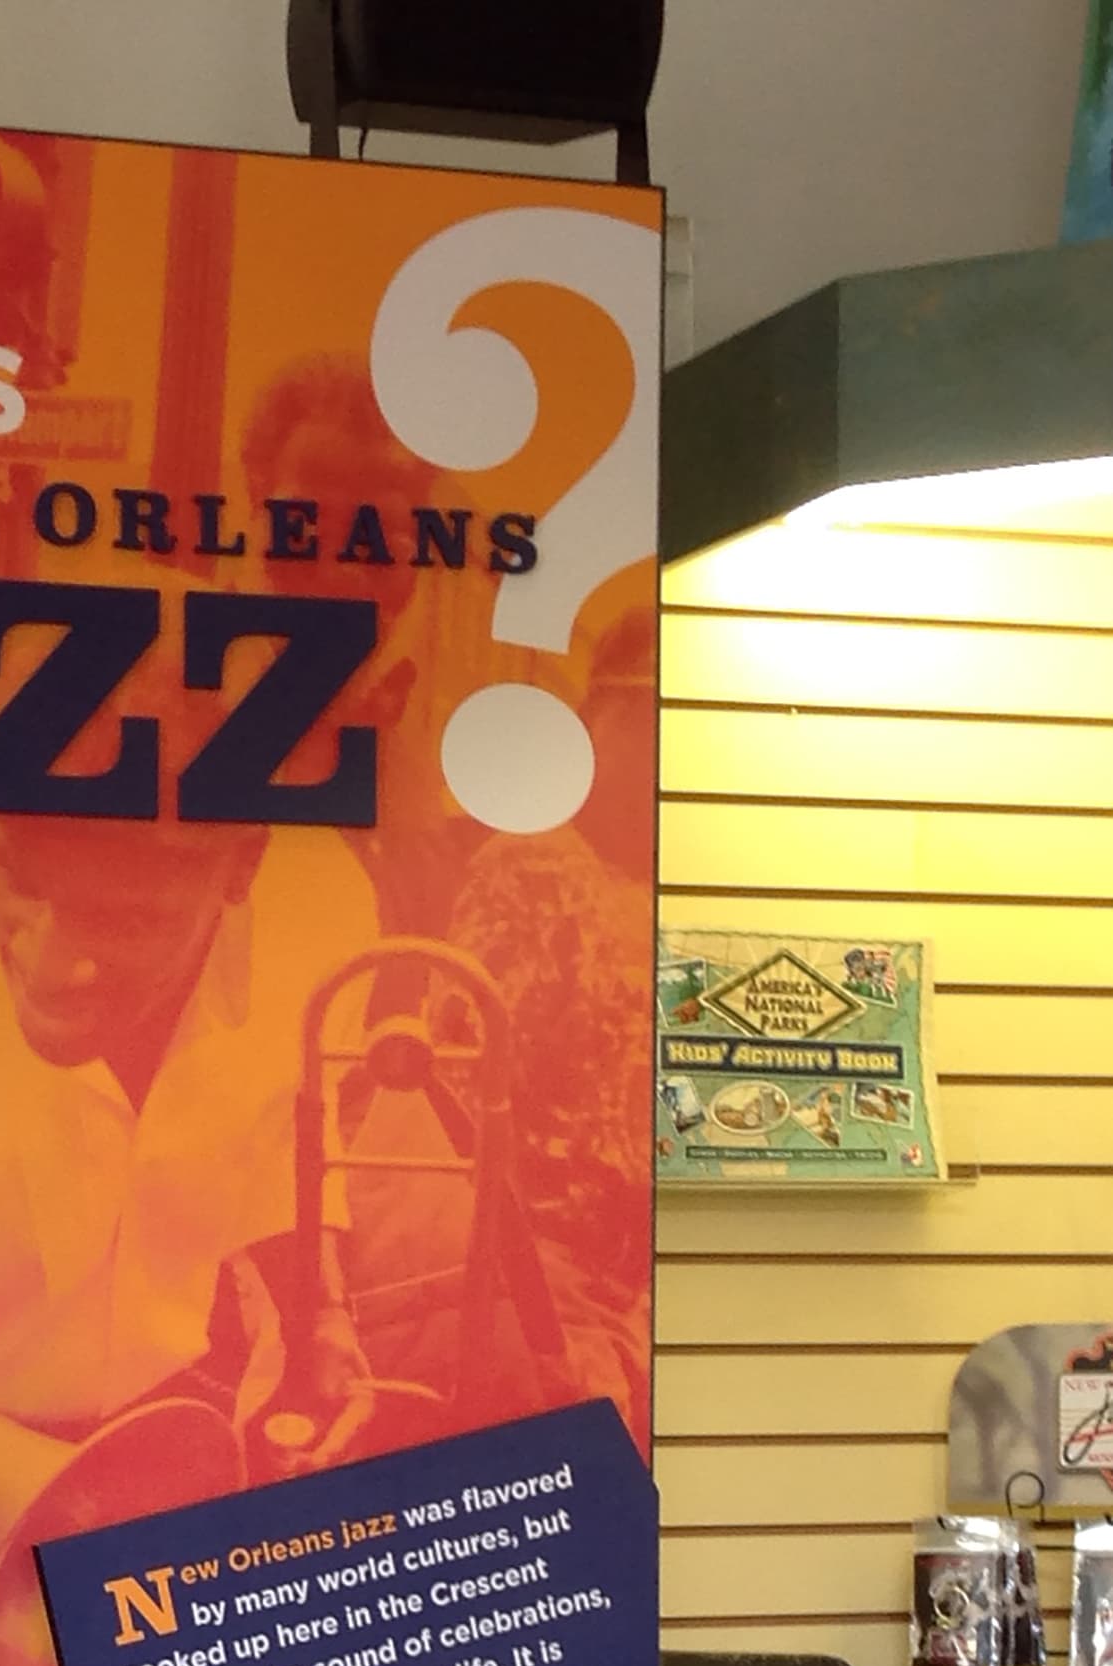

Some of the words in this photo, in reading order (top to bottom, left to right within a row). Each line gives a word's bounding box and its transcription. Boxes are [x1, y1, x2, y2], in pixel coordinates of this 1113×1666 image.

[34, 480, 540, 576] ORLEANS
[745, 996, 824, 1015] NATIONAL
[760, 1015, 809, 1031] PARKS
[733, 1046, 832, 1068] ACTIVITY
[837, 1051, 898, 1071] BOOK
[228, 1530, 336, 1572] Orleans
[340, 1514, 397, 1549] jazz
[402, 1499, 456, 1528] was
[461, 1463, 573, 1513] flavored
[190, 1600, 226, 1626] by
[234, 1579, 309, 1615] many
[316, 1551, 397, 1593] world
[403, 1528, 519, 1571] cultures,
[523, 1509, 571, 1540] but
[233, 1634, 270, 1659] up
[275, 1616, 339, 1648] here
[344, 1605, 372, 1629] in
[377, 1594, 423, 1621] the
[430, 1557, 549, 1606] Crescent
[404, 1627, 432, 1657] of
[439, 1588, 611, 1648] celebrations,
[539, 1640, 563, 1664] is
